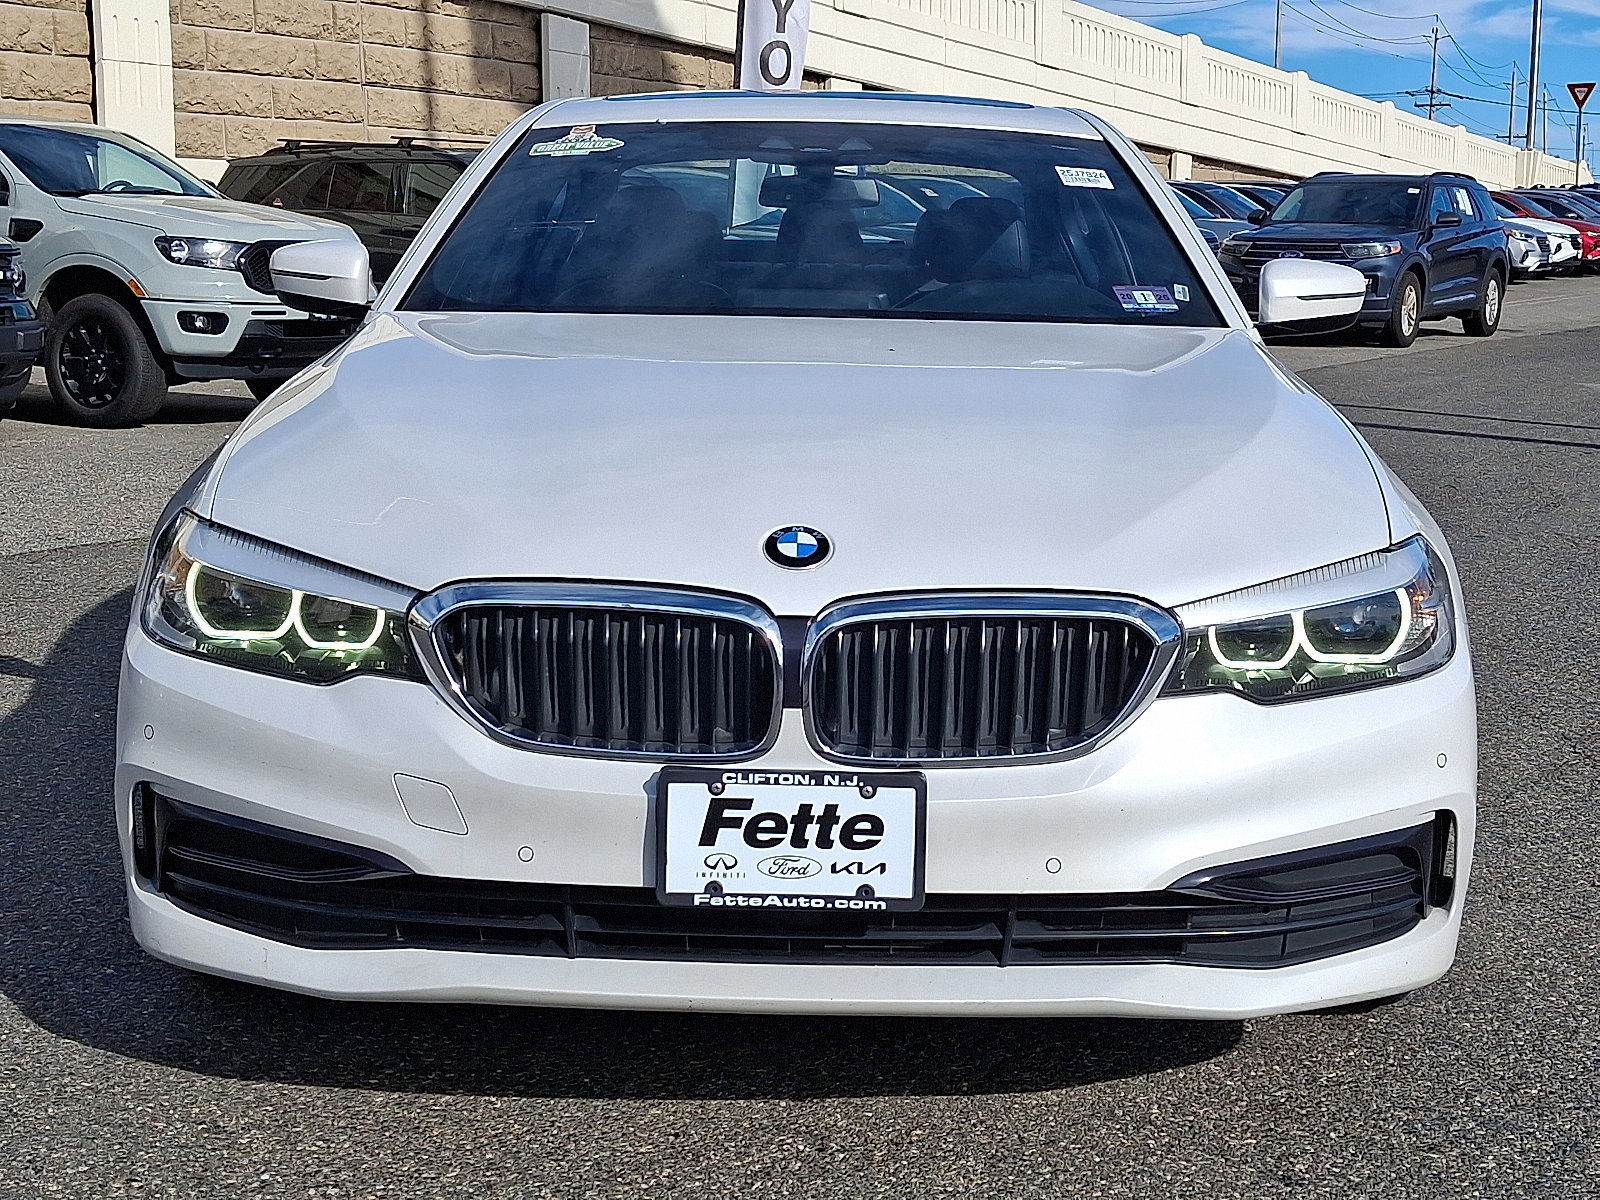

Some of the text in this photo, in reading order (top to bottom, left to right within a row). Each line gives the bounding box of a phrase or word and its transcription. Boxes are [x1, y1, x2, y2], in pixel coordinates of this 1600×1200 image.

[537, 141, 610, 152] GREAT VALUE
[1141, 293, 1149, 302] 1
[772, 527, 825, 539] BMW
[722, 773, 865, 787] CLIFTON, N.J.
[698, 797, 885, 850] Fette
[768, 858, 810, 876] Ford
[831, 861, 887, 875] KIA
[693, 893, 887, 910] FetteAuto.com
